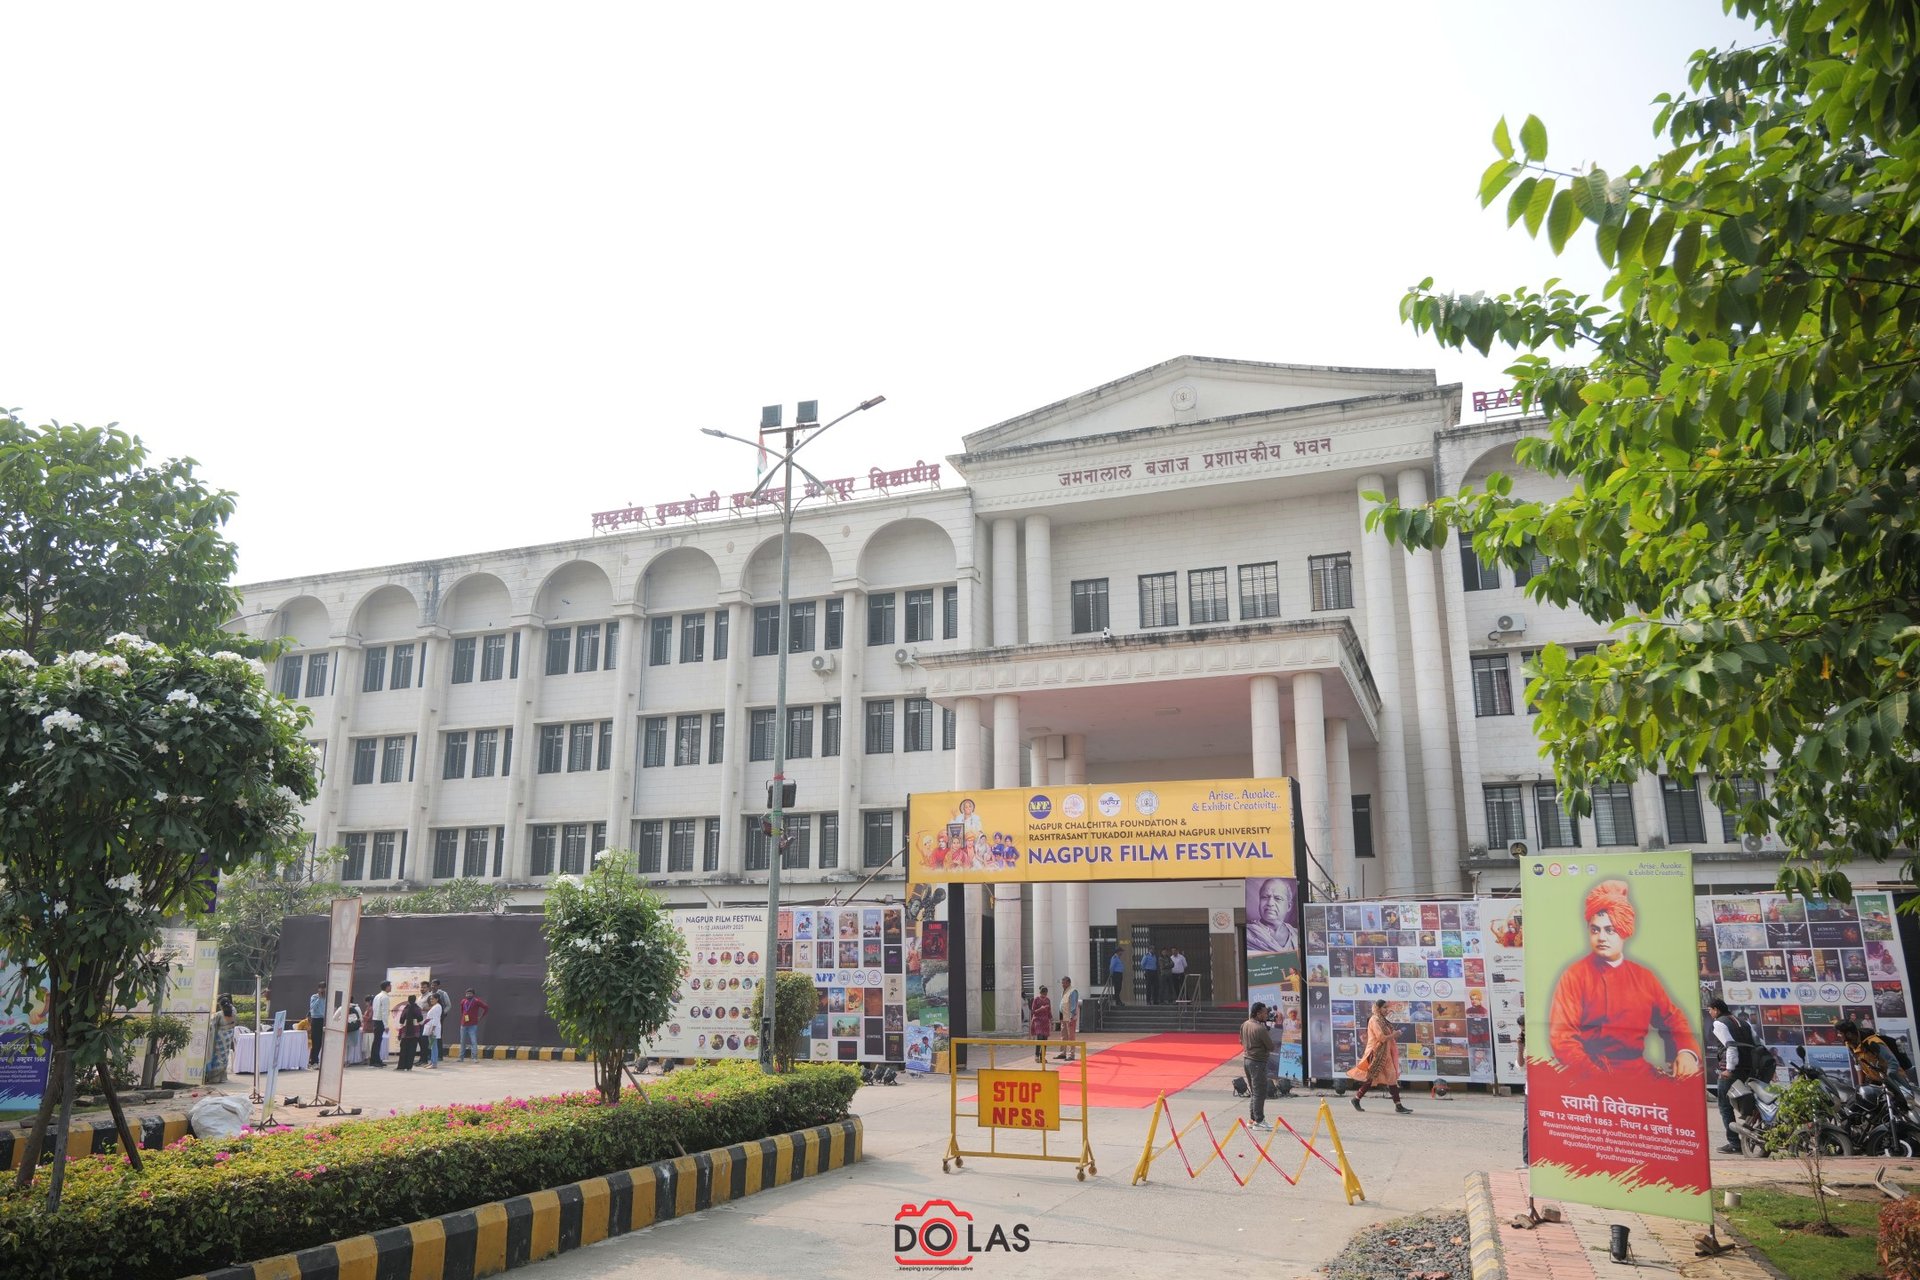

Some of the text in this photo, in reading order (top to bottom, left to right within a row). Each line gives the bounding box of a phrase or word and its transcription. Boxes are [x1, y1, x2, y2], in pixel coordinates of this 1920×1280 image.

[1058, 437, 1332, 487] जमनालाल बजाज प्रशासकीय भवन
[1191, 803, 1199, 812] &
[1202, 802, 1231, 811] Exhibit
[1028, 818, 1187, 831] NAGPUR CHALCHITRA FOUNDATION &
[1028, 826, 1271, 842] RASHTRASANT TUKADOJI MAHARAJ NAGPUR UNIVERSITY
[1028, 841, 1273, 865] NAGPUR FILM FESTIVAL
[685, 914, 763, 924] NAGPUR FILM FESTIVAL
[1363, 983, 1391, 994] NFF
[1759, 987, 1791, 999] NFF
[993, 1081, 1042, 1103] STOP
[1560, 1094, 1669, 1122] स्वामी विवेकानंद
[1538, 1109, 1555, 1118] जन्म
[1556, 1112, 1566, 1120] 12
[1566, 1113, 1592, 1124] जनवरी
[1593, 1117, 1613, 1127] 1863
[1620, 1118, 1642, 1130] निधन
[1650, 1123, 1673, 1135] जुलाई
[1675, 1128, 1696, 1138] 1902
[1602, 1128, 1638, 1140] #youthicon
[1638, 1133, 1700, 1149] #nationalyouthday
